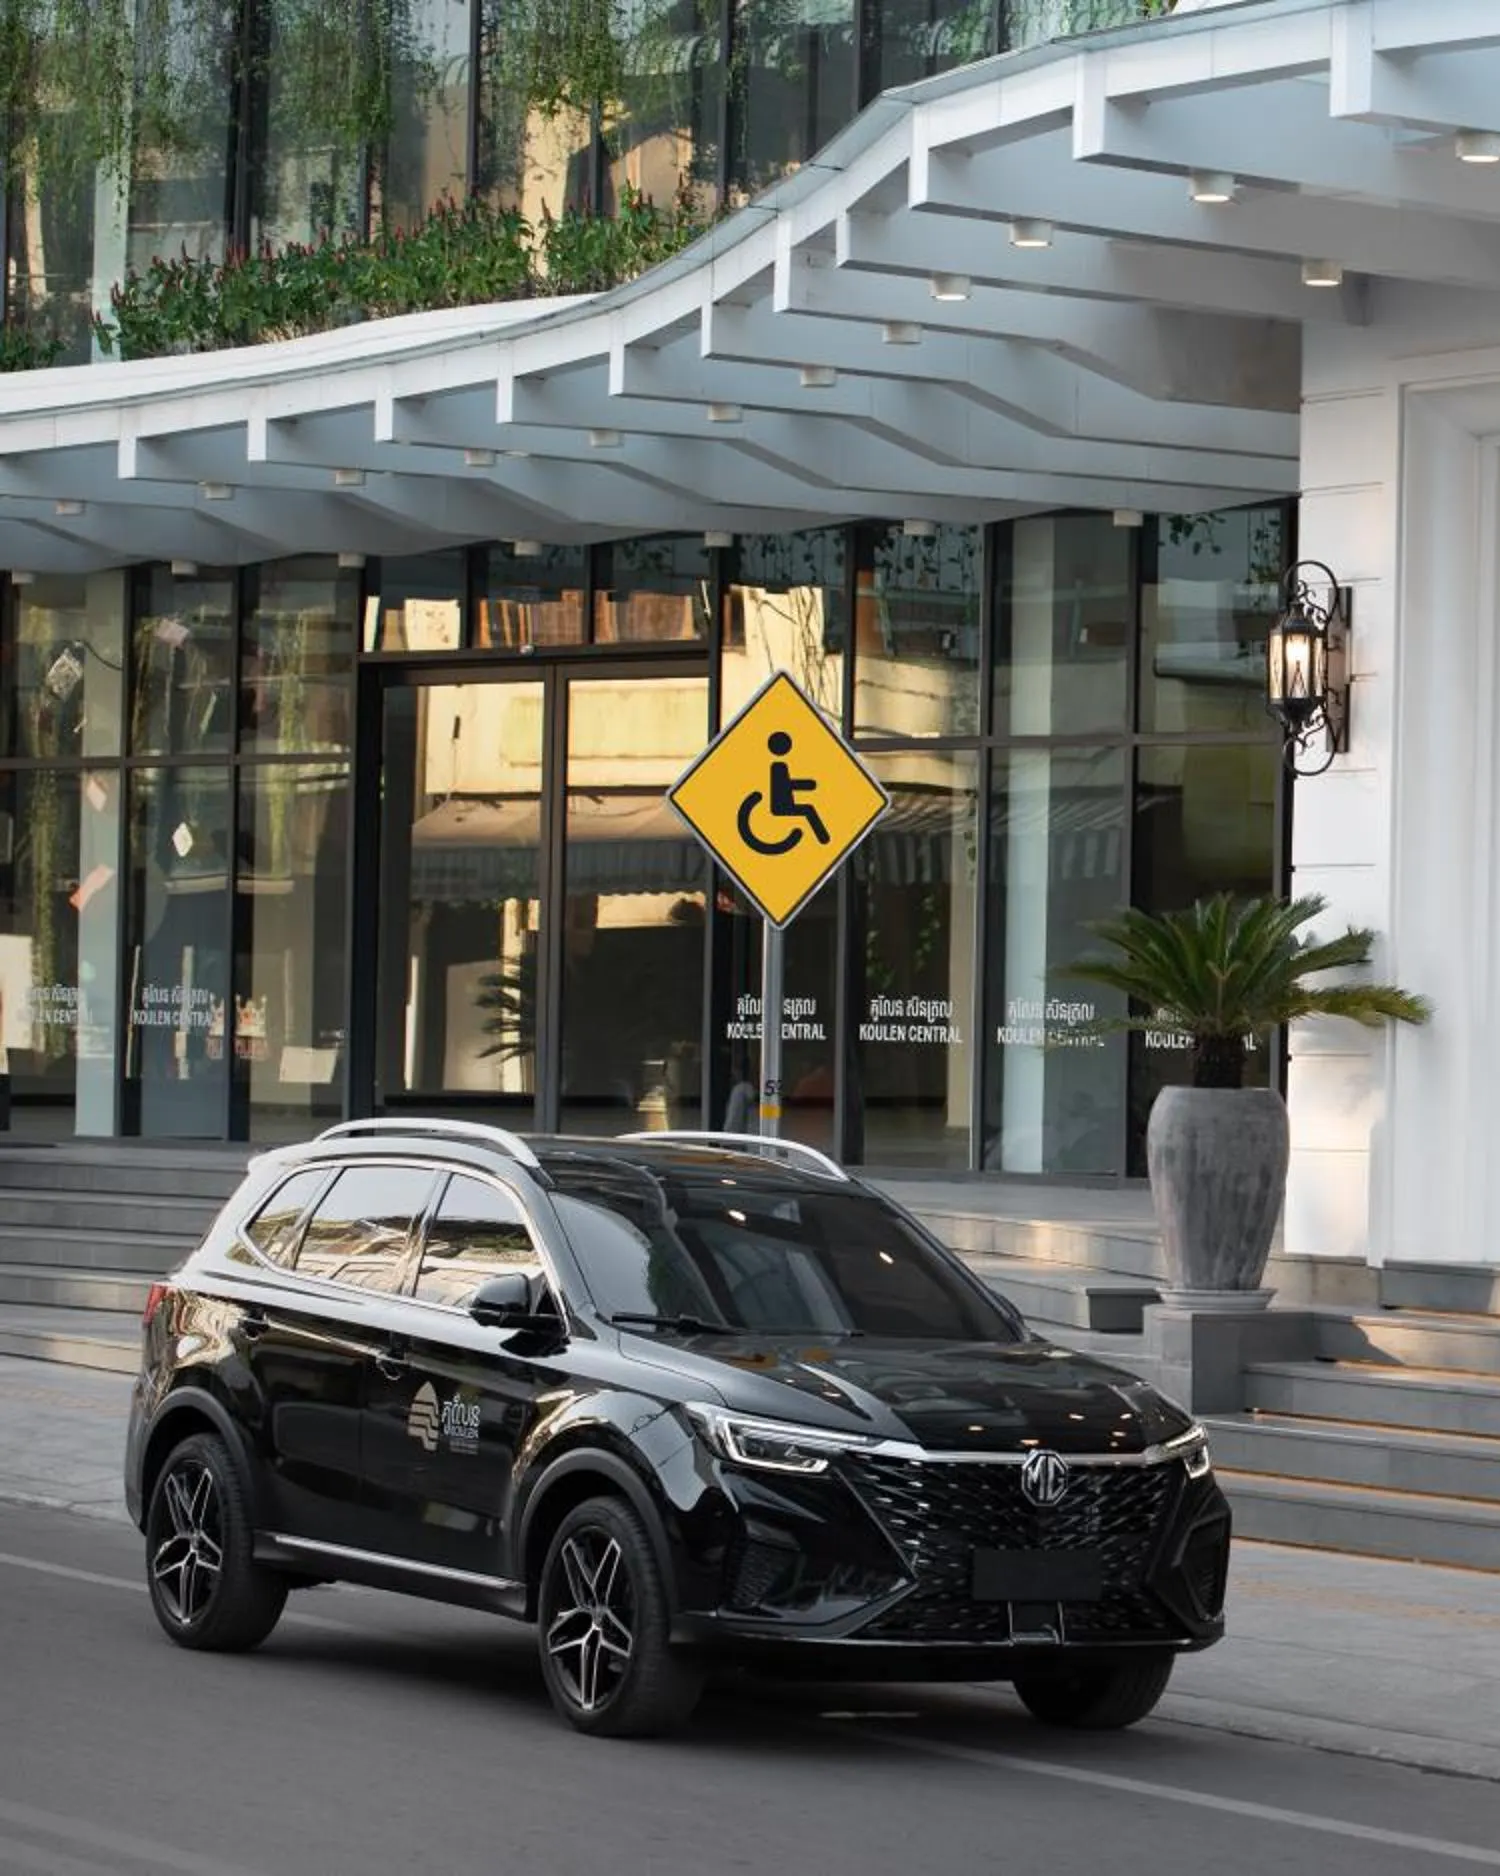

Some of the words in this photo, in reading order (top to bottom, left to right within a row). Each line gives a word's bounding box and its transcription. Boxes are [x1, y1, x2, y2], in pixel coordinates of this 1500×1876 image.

[781, 1023, 827, 1041] ENTRAL
[859, 1024, 906, 1041] KOULEN
[908, 1025, 963, 1043] CENTRAL
[997, 1027, 1044, 1045] KOULEN
[1027, 1455, 1065, 1500] MG
